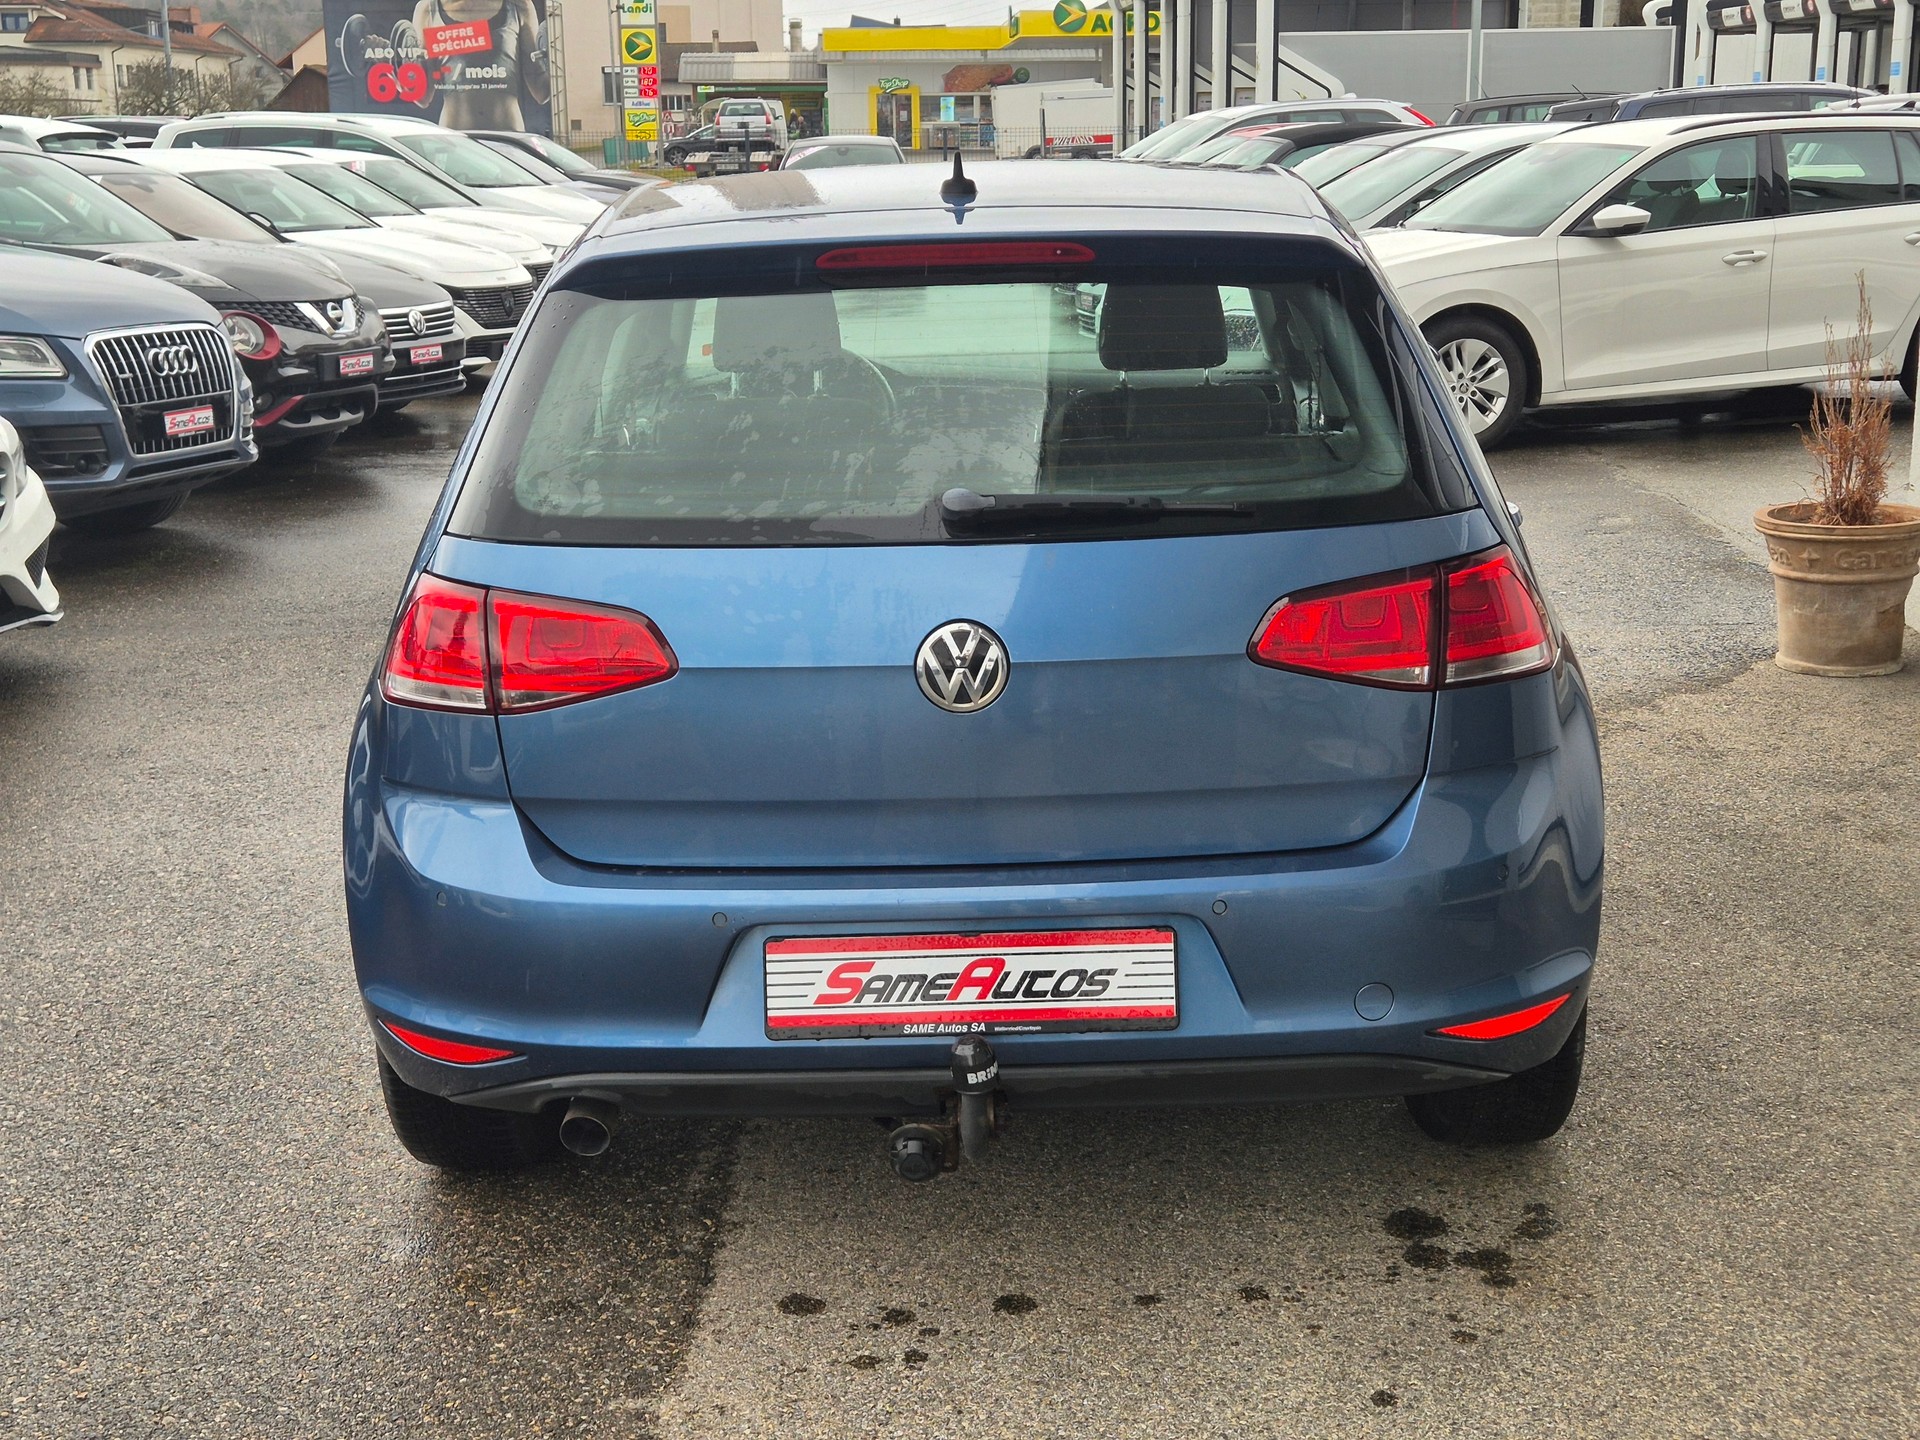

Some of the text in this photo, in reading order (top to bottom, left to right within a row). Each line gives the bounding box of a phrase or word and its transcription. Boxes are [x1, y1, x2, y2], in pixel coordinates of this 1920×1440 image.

[622, 3, 652, 13] Landi
[1091, 12, 1160, 32] AO
[436, 27, 474, 40] OFFRE
[432, 36, 486, 53] SPÉCIALE
[364, 47, 395, 59] ABO
[465, 63, 507, 79] mois
[1053, 135, 1095, 146] WIELAND
[903, 1023, 936, 1034] SAME
[937, 1023, 968, 1033] Autos
[970, 1022, 986, 1032] SA
